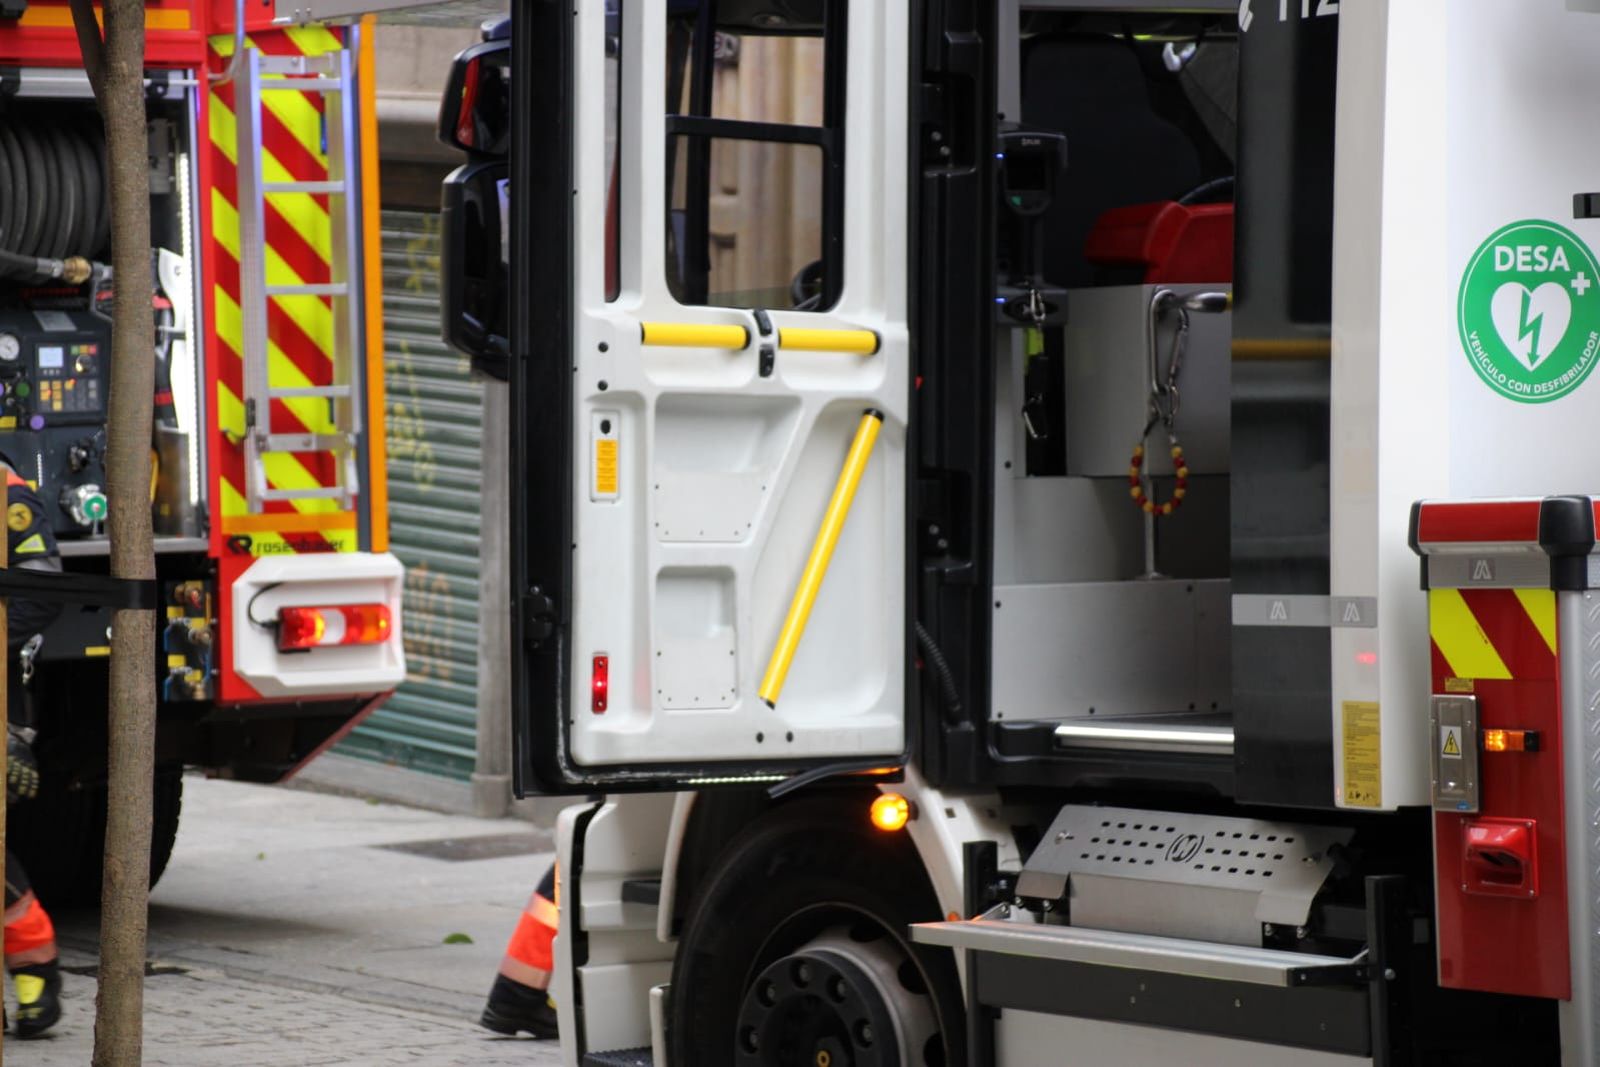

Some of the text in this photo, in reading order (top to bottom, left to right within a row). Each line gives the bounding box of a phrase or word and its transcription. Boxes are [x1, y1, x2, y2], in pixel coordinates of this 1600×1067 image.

[1495, 245, 1570, 272] DESA
[1469, 330, 1599, 393] VEHÍCULO CON DESFIBRILADOR
